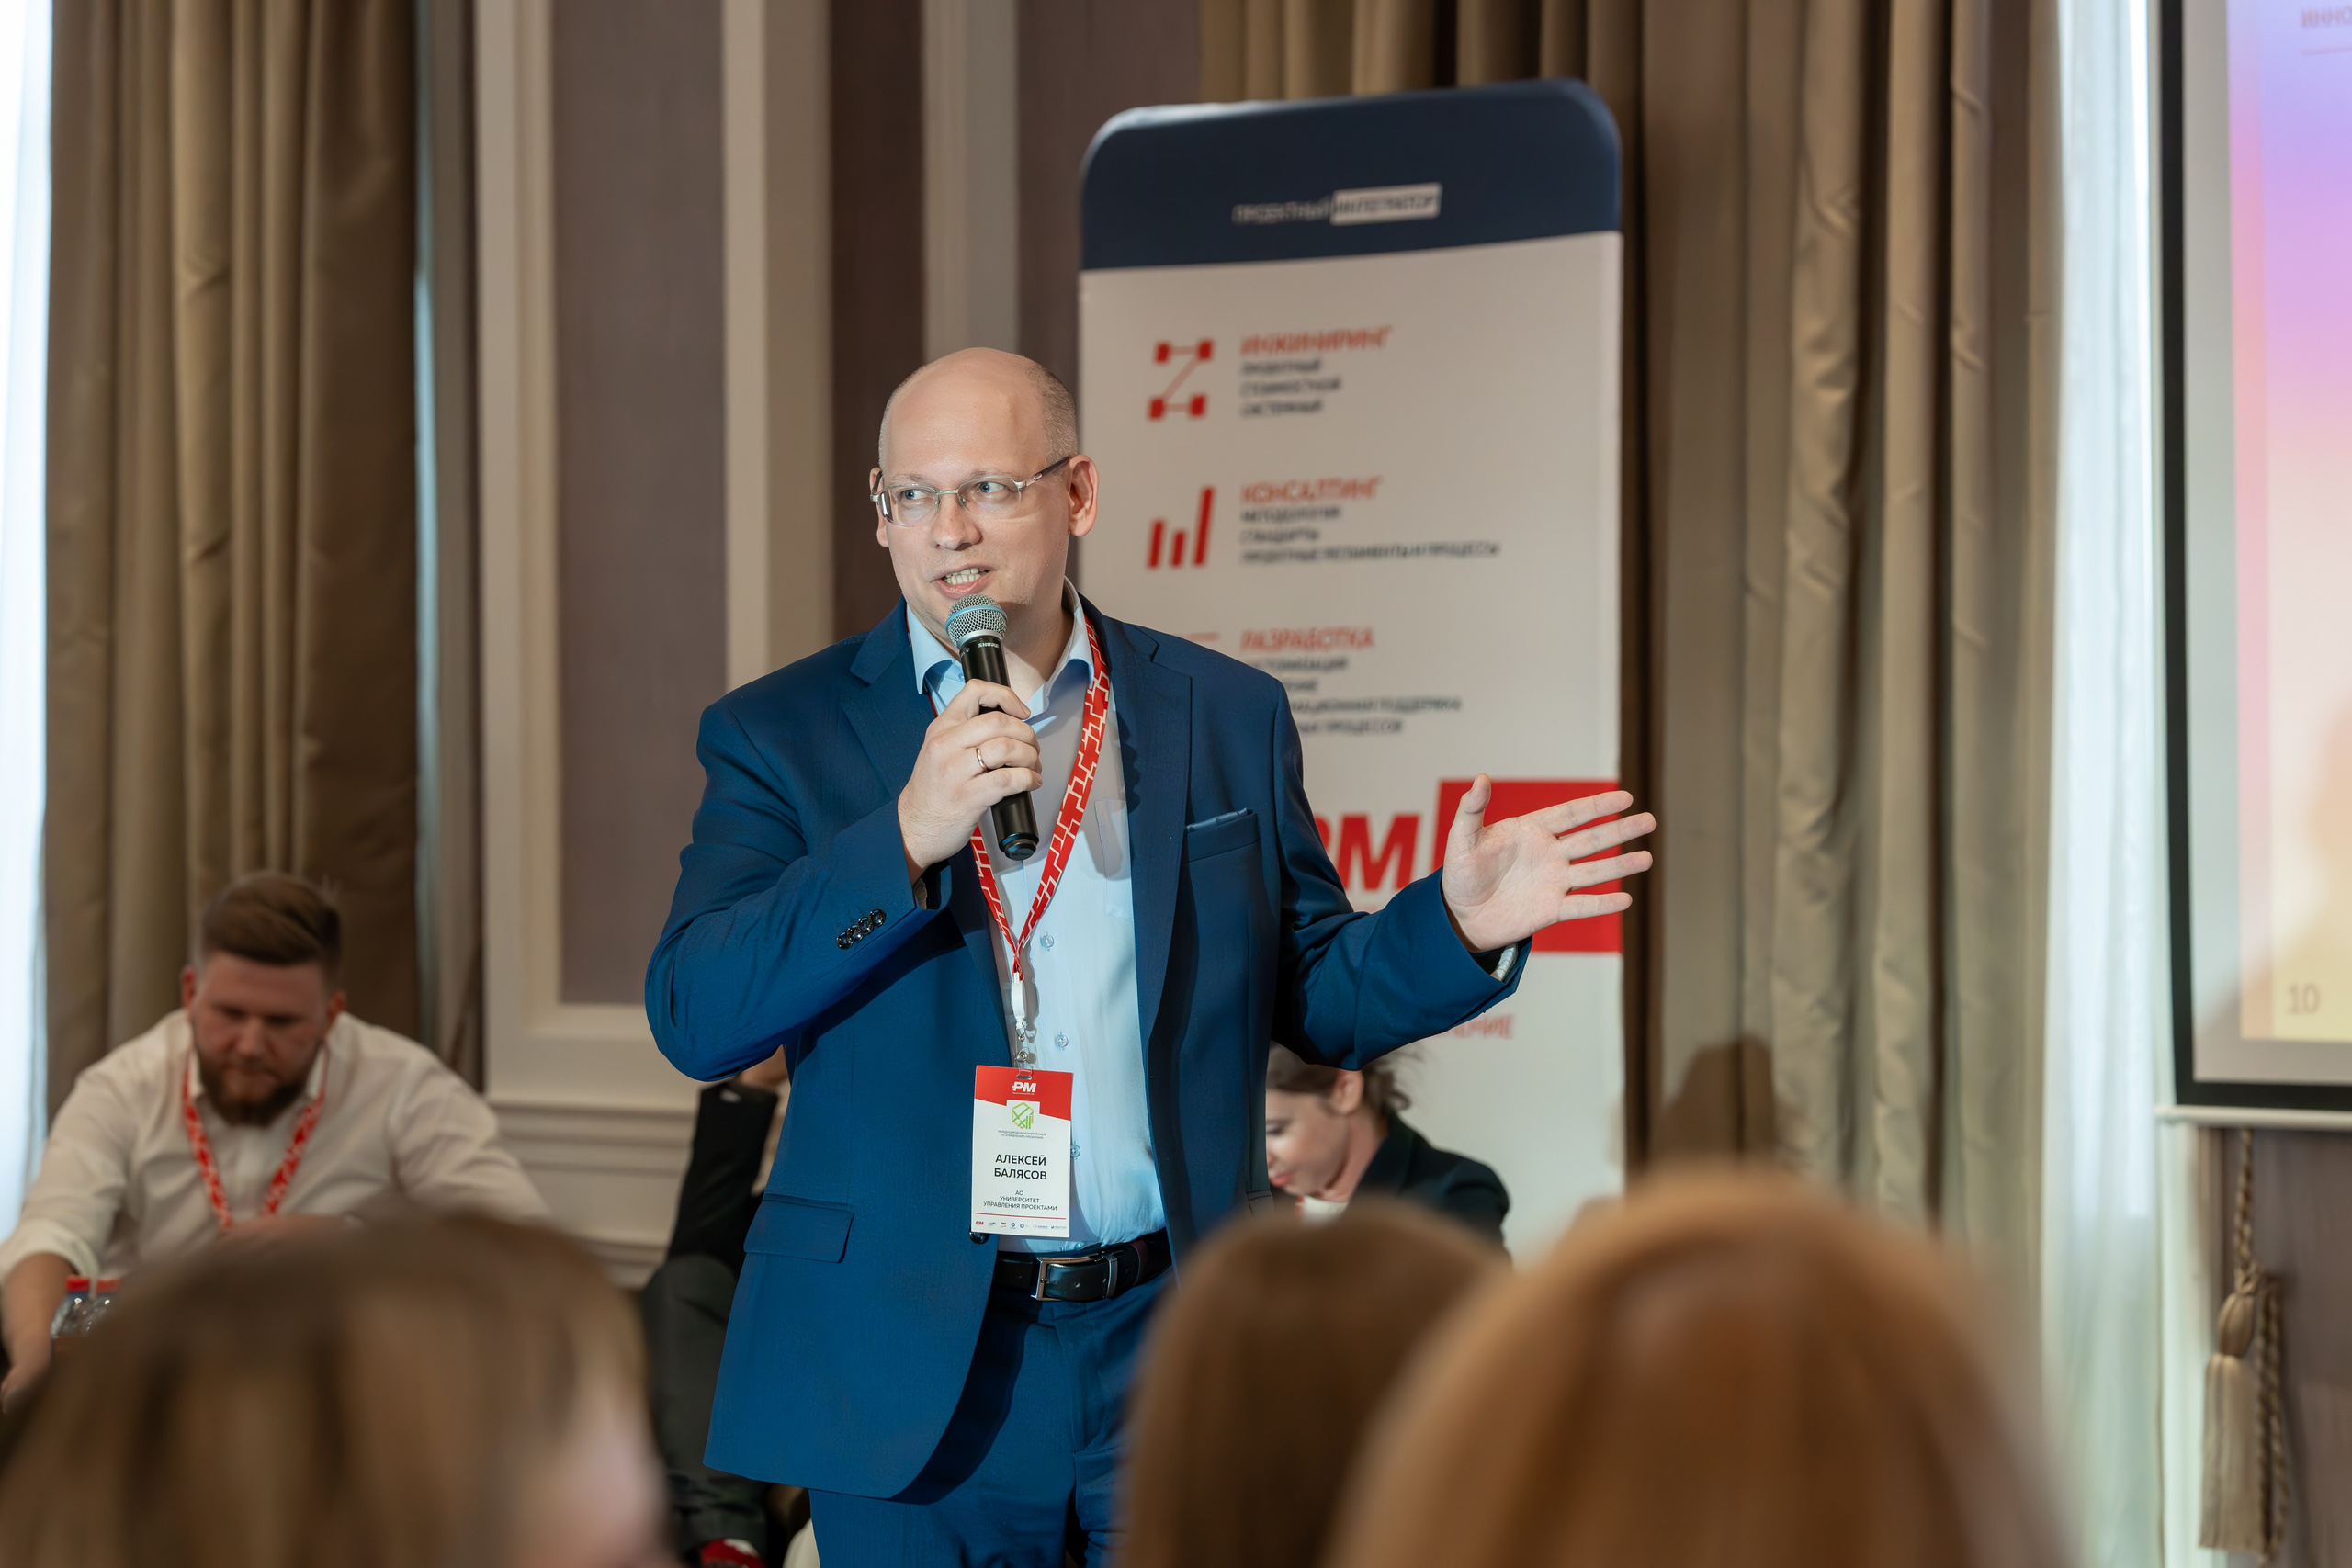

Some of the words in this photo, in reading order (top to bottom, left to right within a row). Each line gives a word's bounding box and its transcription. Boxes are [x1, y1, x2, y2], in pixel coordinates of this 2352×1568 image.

[1242, 476, 1384, 503] КОНСАЛТИНГ
[2287, 983, 2321, 1015] 10
[995, 1154, 1046, 1167] АЛЕКСЕЙ
[994, 1168, 1047, 1180] БАЛЯСОВ
